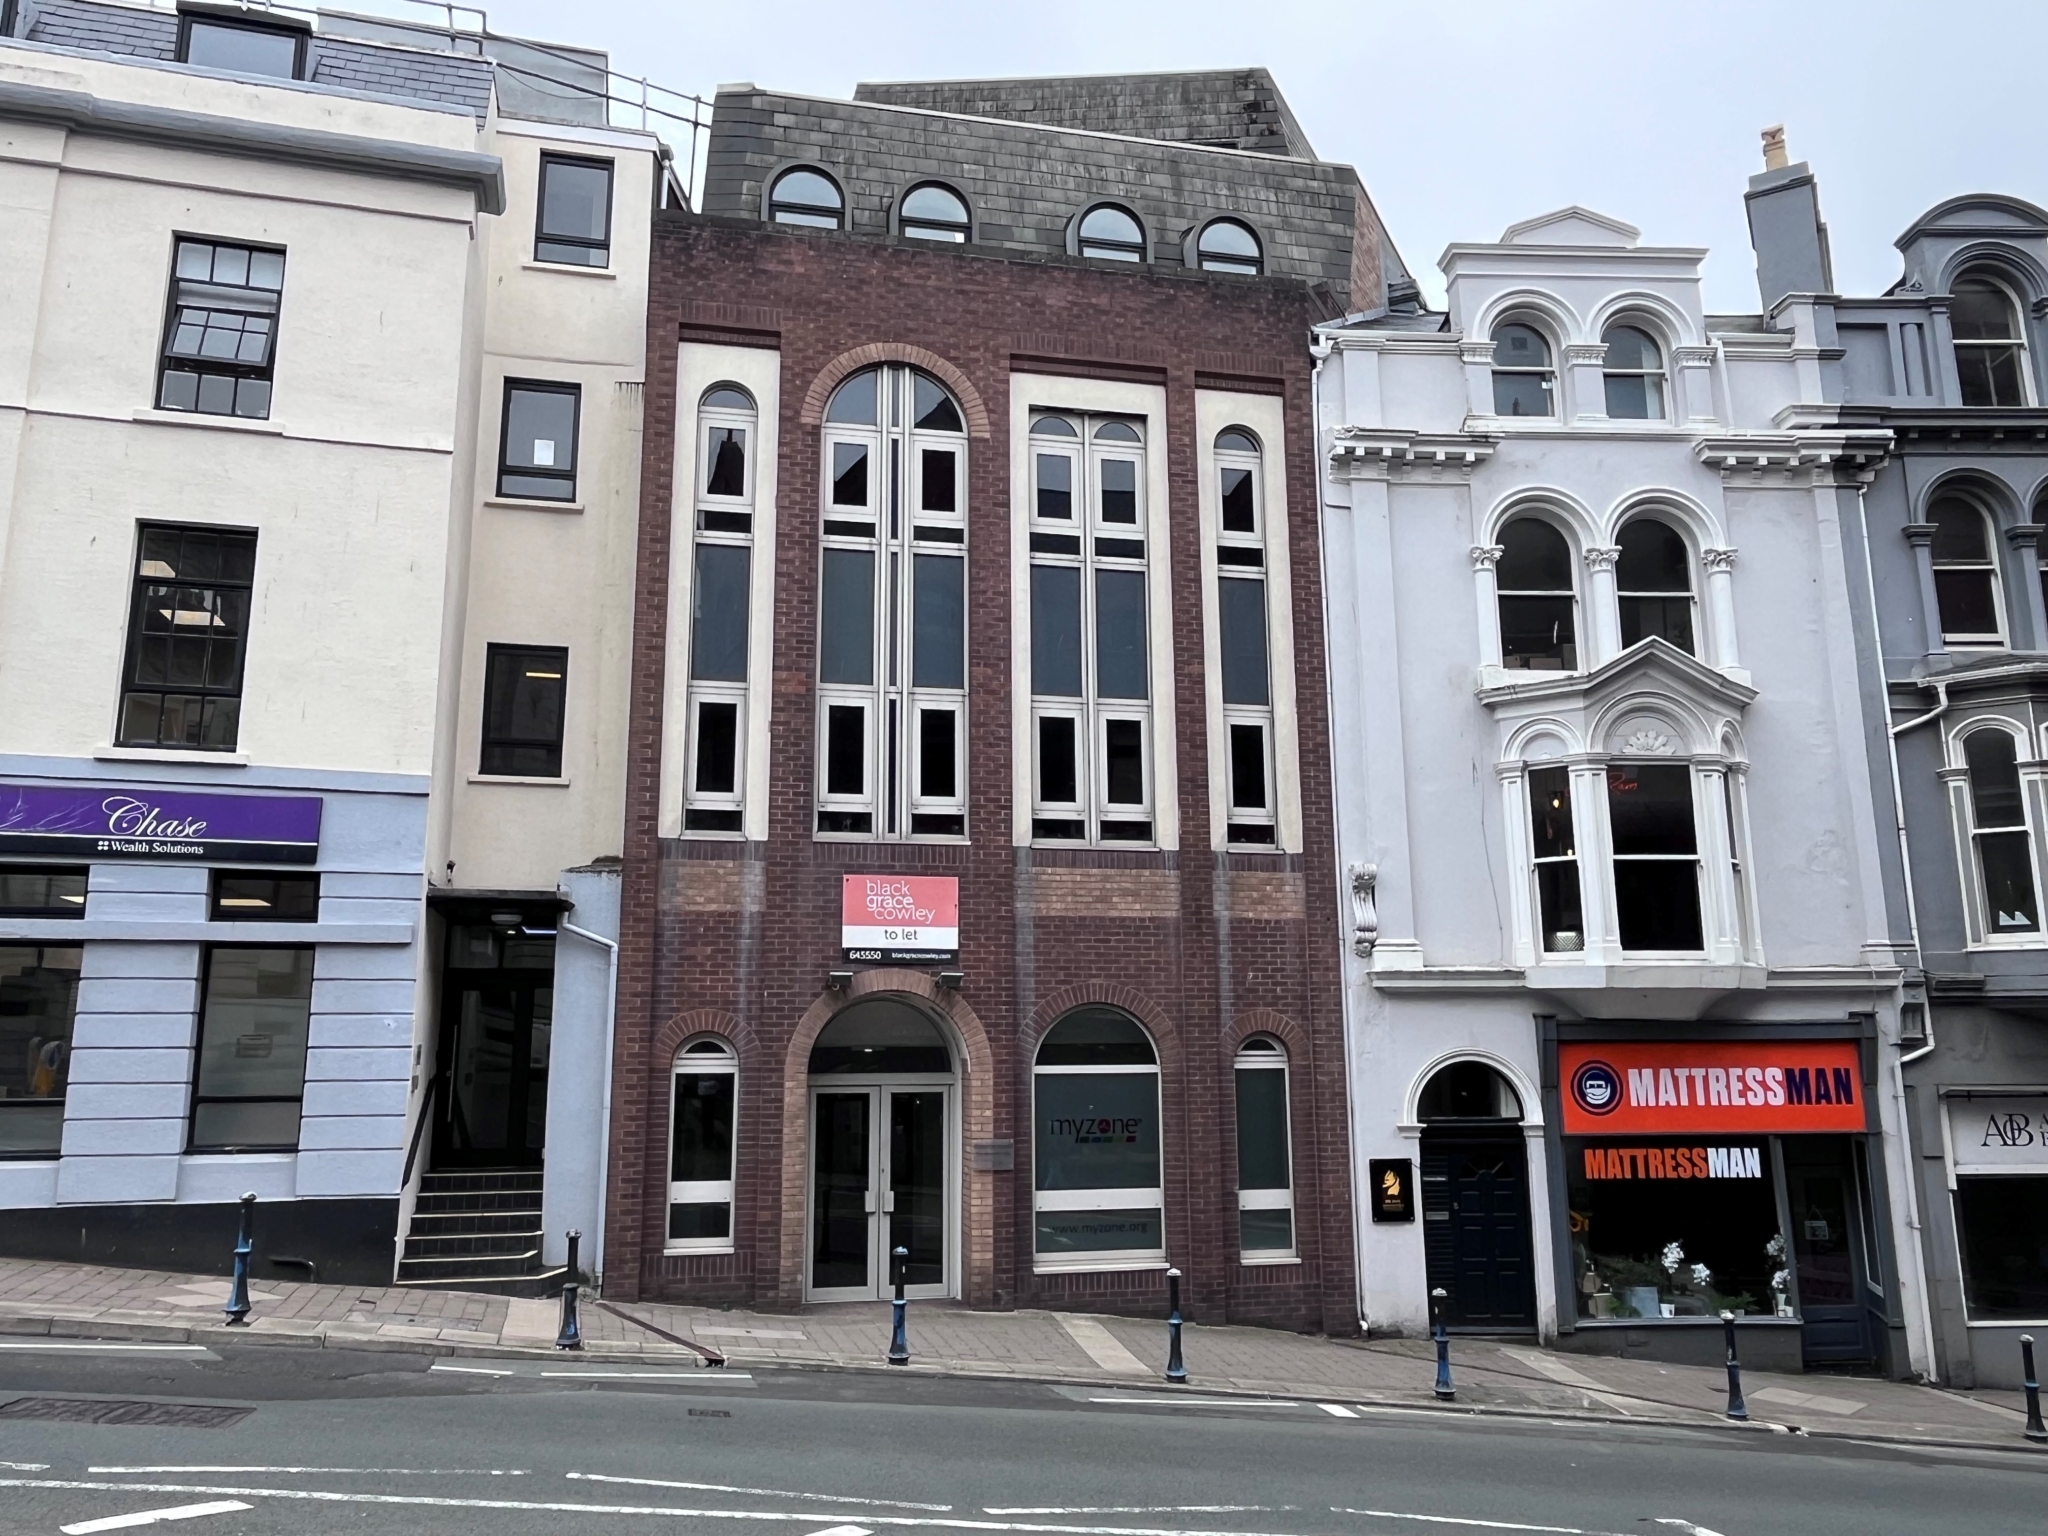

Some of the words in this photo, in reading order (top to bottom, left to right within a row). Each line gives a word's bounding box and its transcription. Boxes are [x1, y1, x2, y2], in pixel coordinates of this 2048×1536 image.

[102, 796, 207, 837] Chase
[111, 841, 149, 852] Wealth
[152, 842, 204, 854] Solutions
[866, 879, 910, 895] black
[866, 895, 914, 912] grace
[874, 905, 936, 924] cowley
[884, 929, 898, 940] to
[902, 928, 918, 940] let
[849, 950, 882, 960] 645550
